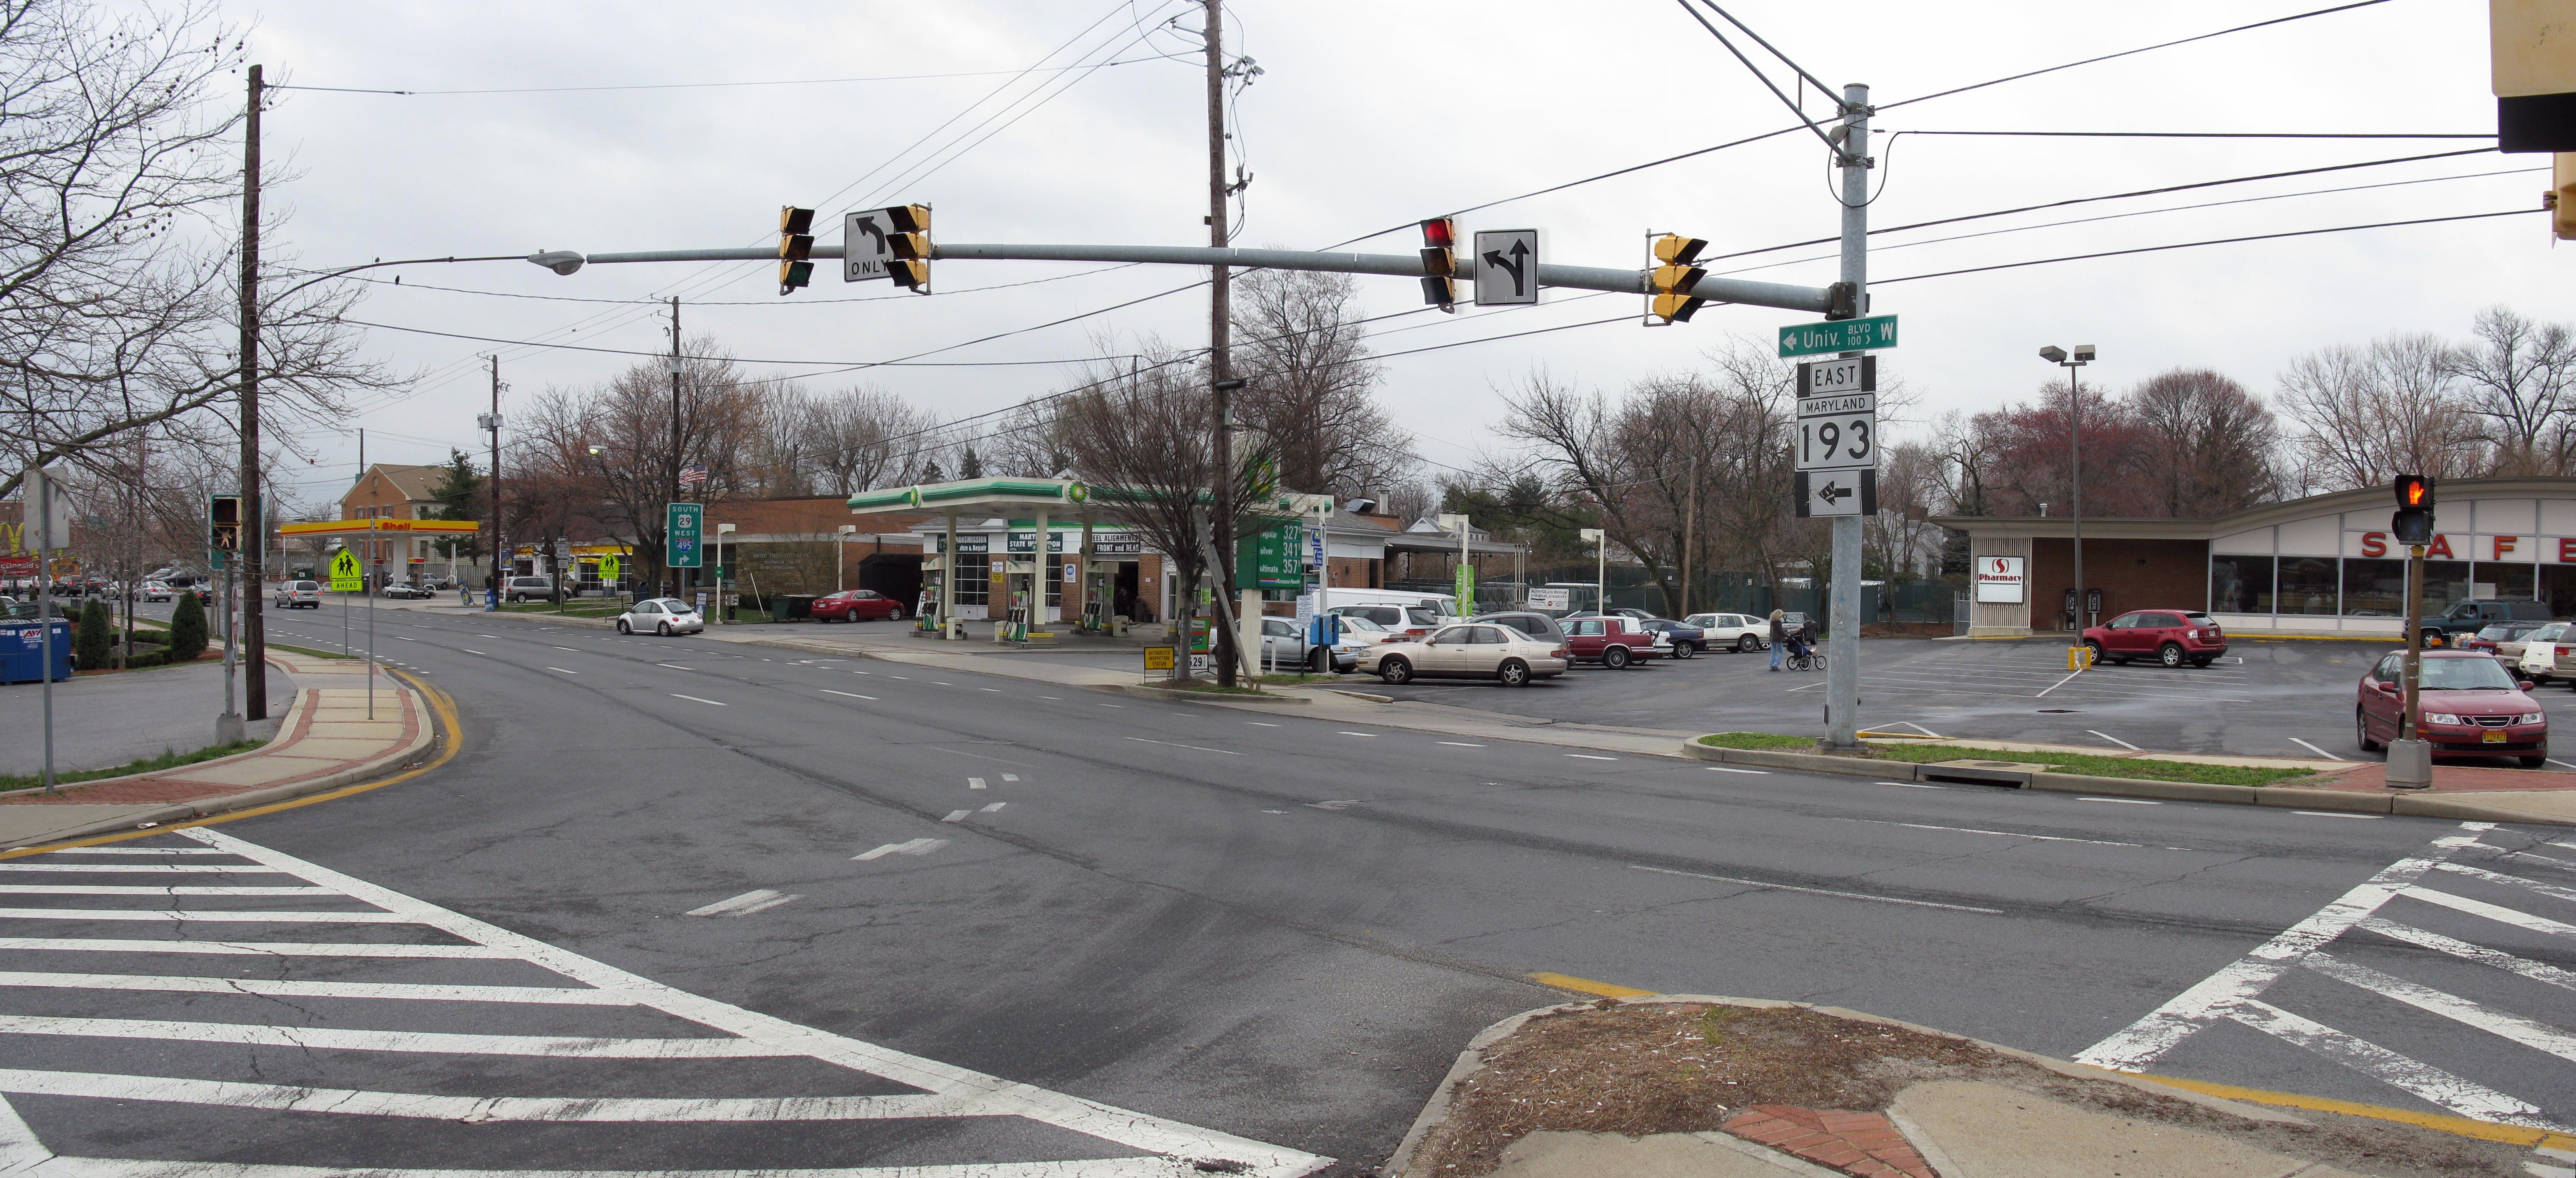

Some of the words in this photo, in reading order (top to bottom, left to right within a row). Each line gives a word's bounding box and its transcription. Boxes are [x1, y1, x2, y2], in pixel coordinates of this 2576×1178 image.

[851, 259, 889, 275] ONLY
[1804, 330, 1840, 348] Univ.
[1848, 323, 1870, 334] BLVD
[1880, 322, 1893, 341] W
[1848, 336, 1861, 346] 100
[1815, 366, 1855, 387] EAST
[1806, 397, 1865, 413] MARYLAND
[1802, 420, 1870, 462] 193
[679, 517, 690, 525] 29
[382, 522, 410, 530] Shell
[1260, 531, 1277, 539] regular
[678, 542, 691, 550] 495
[1260, 546, 1273, 554] silver
[1259, 565, 1278, 573] ultimate
[1979, 573, 2022, 582] Pharmacy
